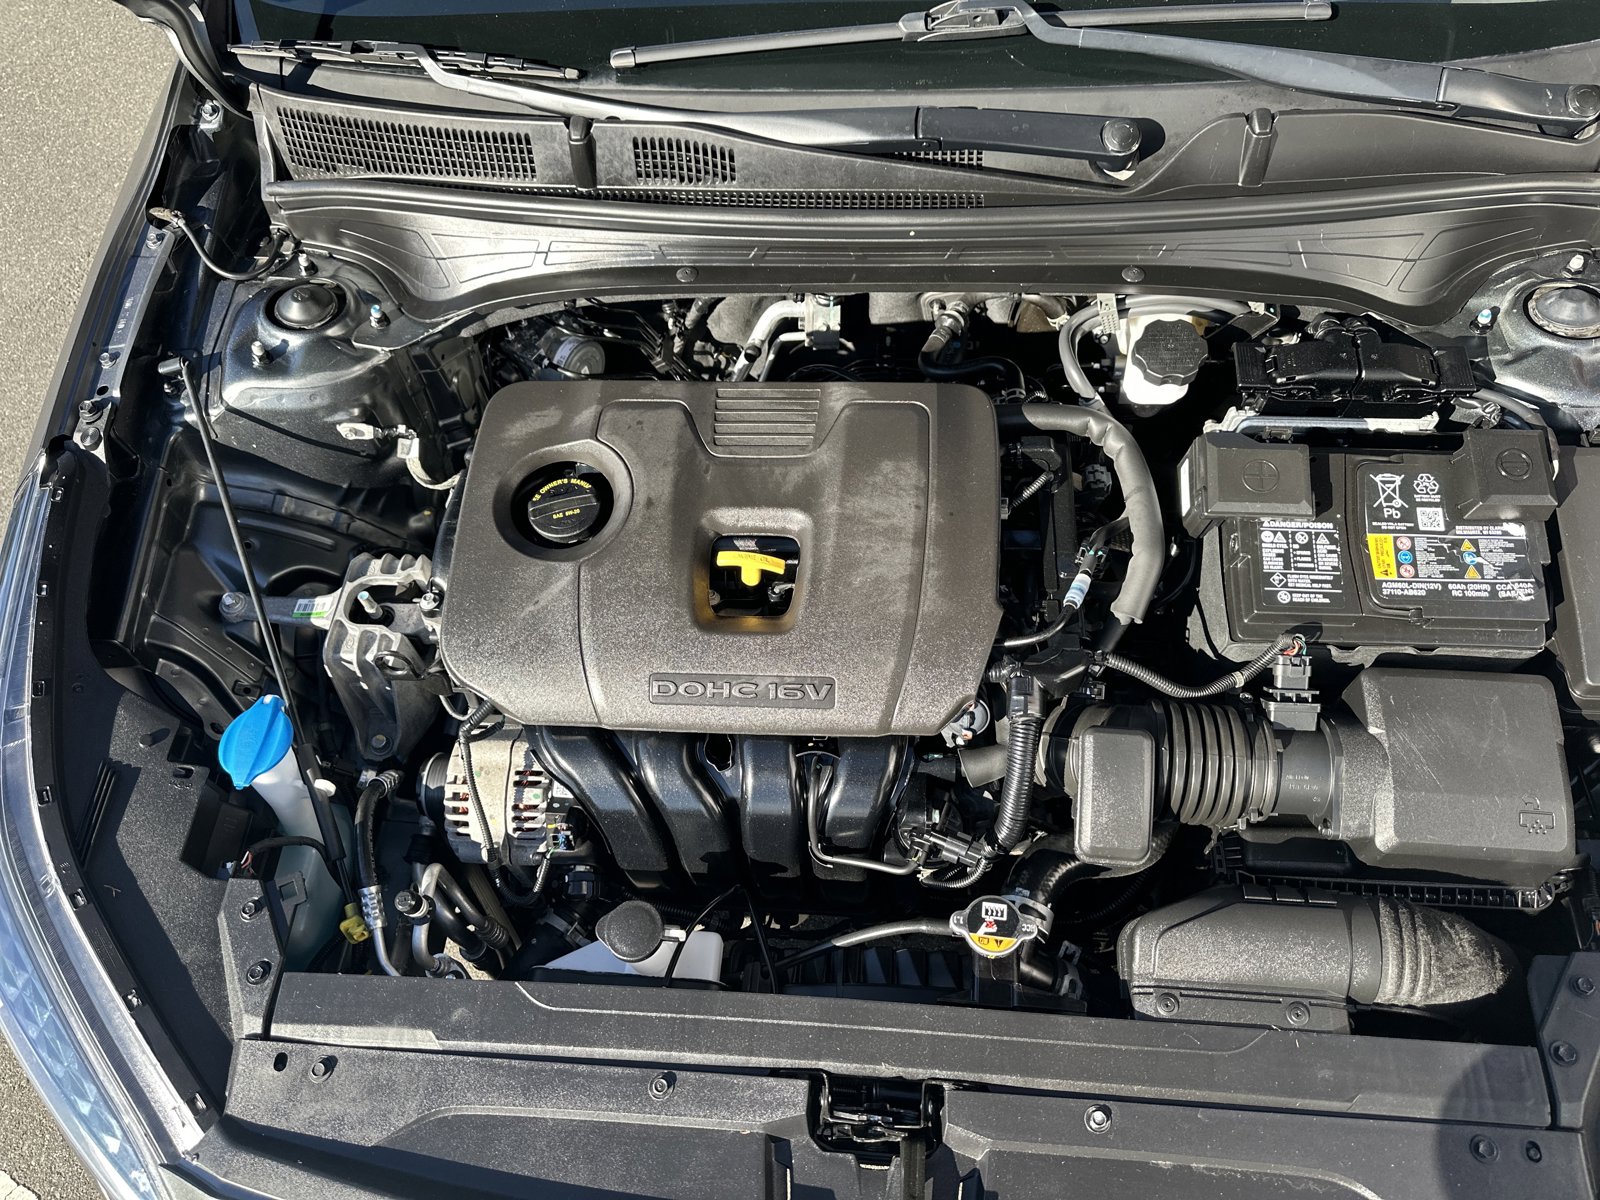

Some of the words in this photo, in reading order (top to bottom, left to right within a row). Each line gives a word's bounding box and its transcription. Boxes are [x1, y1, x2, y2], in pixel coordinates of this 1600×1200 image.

[540, 478, 568, 494] OWNER'S
[1383, 508, 1401, 519] Pb
[1270, 521, 1333, 529] DANGER/POISON
[1467, 583, 1491, 592] (20HR)
[652, 680, 758, 699] DOHC
[768, 683, 833, 701] 16V
